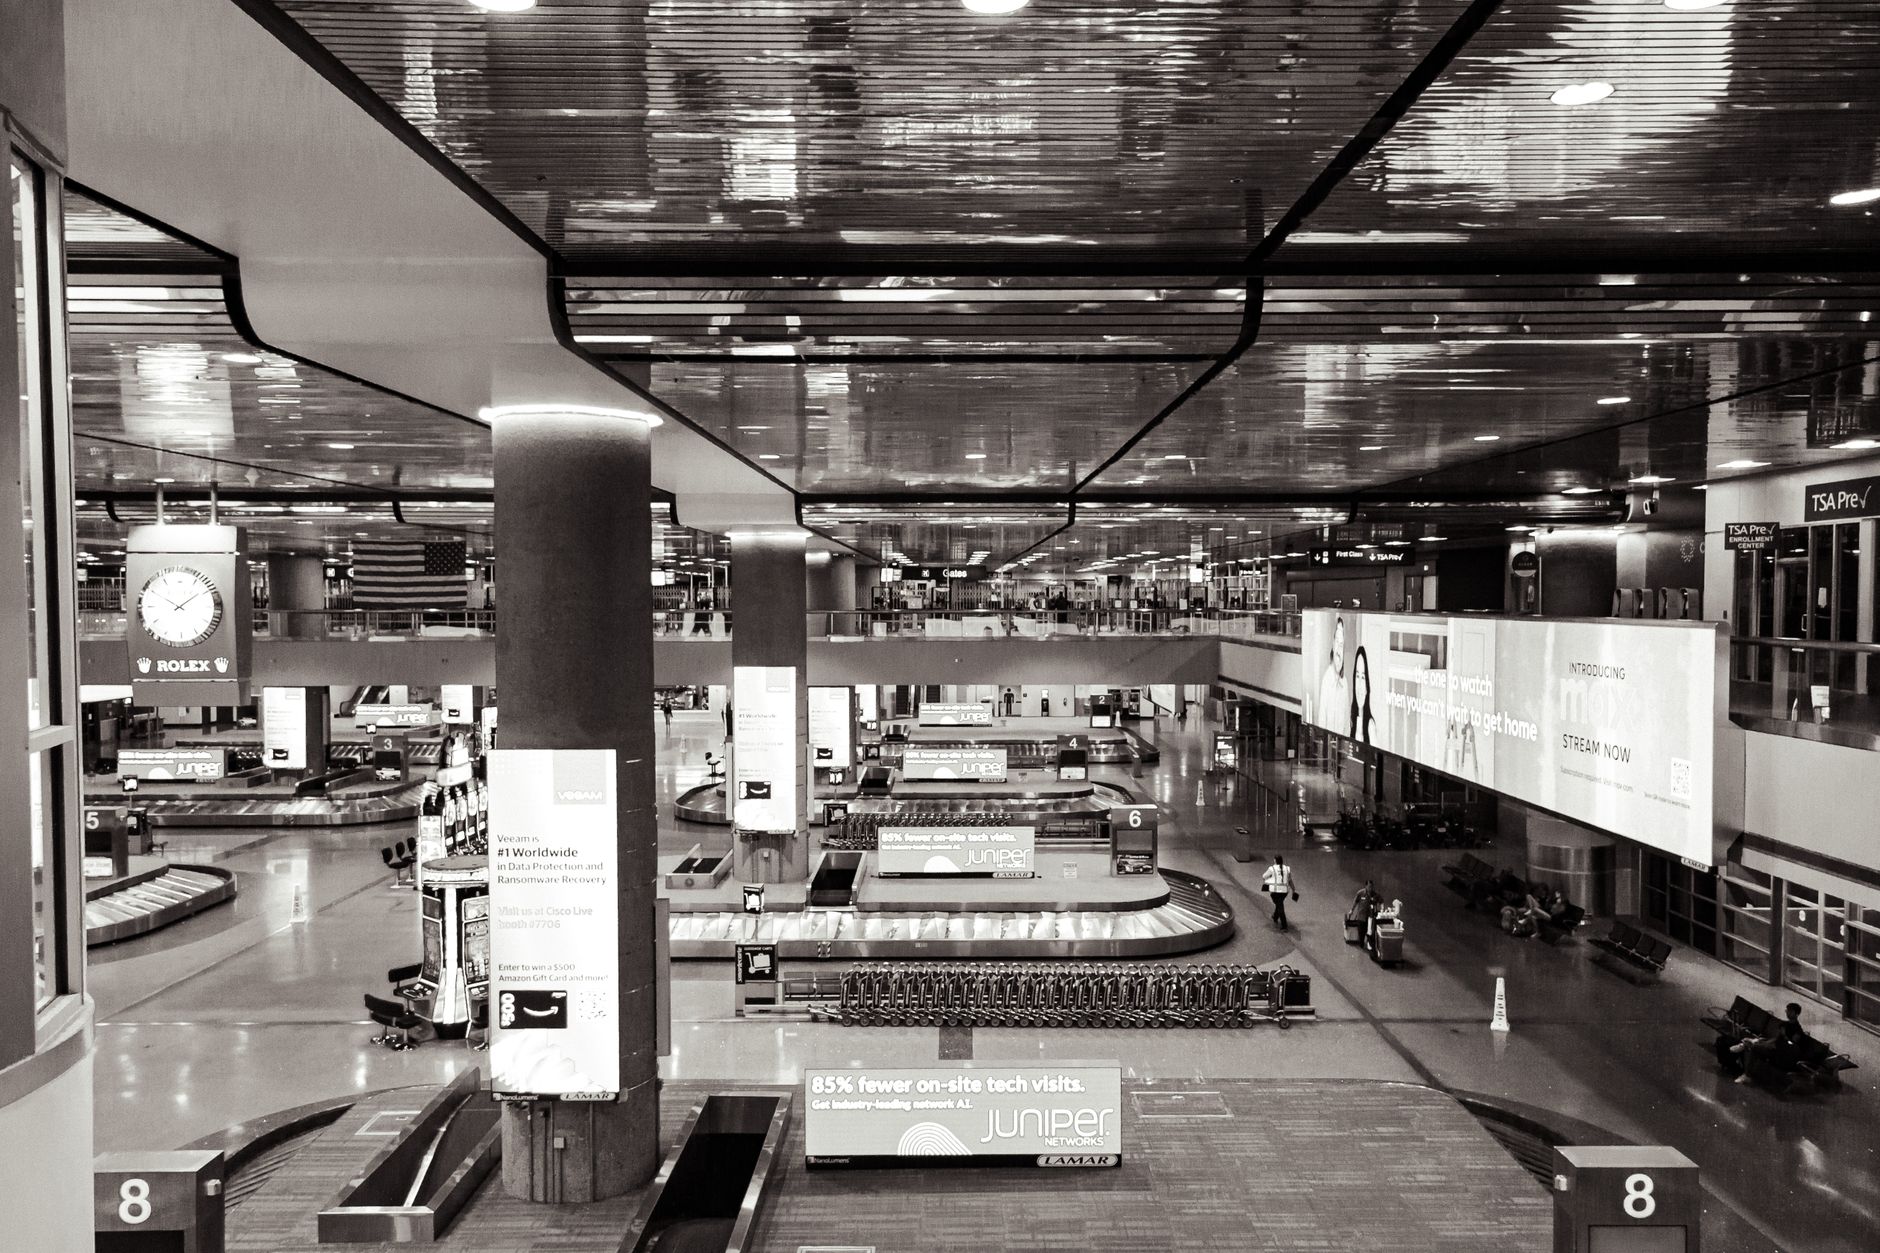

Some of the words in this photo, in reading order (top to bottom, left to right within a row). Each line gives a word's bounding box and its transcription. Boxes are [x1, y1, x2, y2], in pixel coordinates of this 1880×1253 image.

[1812, 493, 1836, 512] TSA
[1728, 525, 1747, 535] TSA
[943, 569, 967, 578] Gates
[157, 660, 211, 672] ROLEX
[1569, 662, 1626, 680] INTRODUCING
[1414, 666, 1429, 684] the
[1430, 671, 1446, 687] one
[1460, 674, 1492, 697] watch
[1098, 695, 1105, 705] 2
[1385, 688, 1406, 707] when
[1406, 694, 1422, 715] you
[1422, 697, 1445, 719] can't
[1447, 703, 1469, 725] wait
[1469, 707, 1482, 728] to
[1483, 711, 1502, 736] get
[1504, 711, 1538, 741] home
[383, 738, 393, 750] 3
[1069, 737, 1078, 749] 4
[1562, 734, 1600, 756] STREAM
[1604, 743, 1631, 764] NOW
[85, 811, 99, 830] 5
[1128, 809, 1142, 828] 6
[497, 834, 530, 843] Veeam
[532, 834, 540, 843] is
[497, 848, 510, 858] #1
[512, 847, 579, 858] Worldwide
[497, 862, 506, 871] in
[508, 862, 531, 871] Data
[532, 862, 583, 871] Protection
[585, 862, 604, 871] and
[497, 874, 560, 885] Ransomware
[562, 874, 607, 887] Recovery
[521, 908, 532, 916] us
[534, 906, 544, 916] at
[546, 906, 571, 916] Cisco
[573, 906, 593, 916] Live
[498, 963, 520, 971] Enter
[521, 963, 530, 971] to
[531, 963, 546, 971] win
[553, 963, 576, 972] $500
[498, 974, 532, 982] Amazon
[532, 974, 547, 982] Gift
[549, 974, 567, 982] Card
[568, 974, 584, 982] and
[811, 1075, 854, 1095] 85%
[857, 1075, 914, 1094] fewer
[915, 1074, 982, 1094] on-site
[986, 1074, 1028, 1094] tech
[1031, 1074, 1086, 1093] visits.
[565, 1092, 611, 1100] LAMAR
[811, 1099, 831, 1110] Get
[912, 1099, 955, 1109] network
[1044, 1136, 1104, 1147] NETWORKS
[1045, 1155, 1110, 1165] LAMAR
[118, 1178, 151, 1224] 8
[1623, 1173, 1656, 1219] 8
